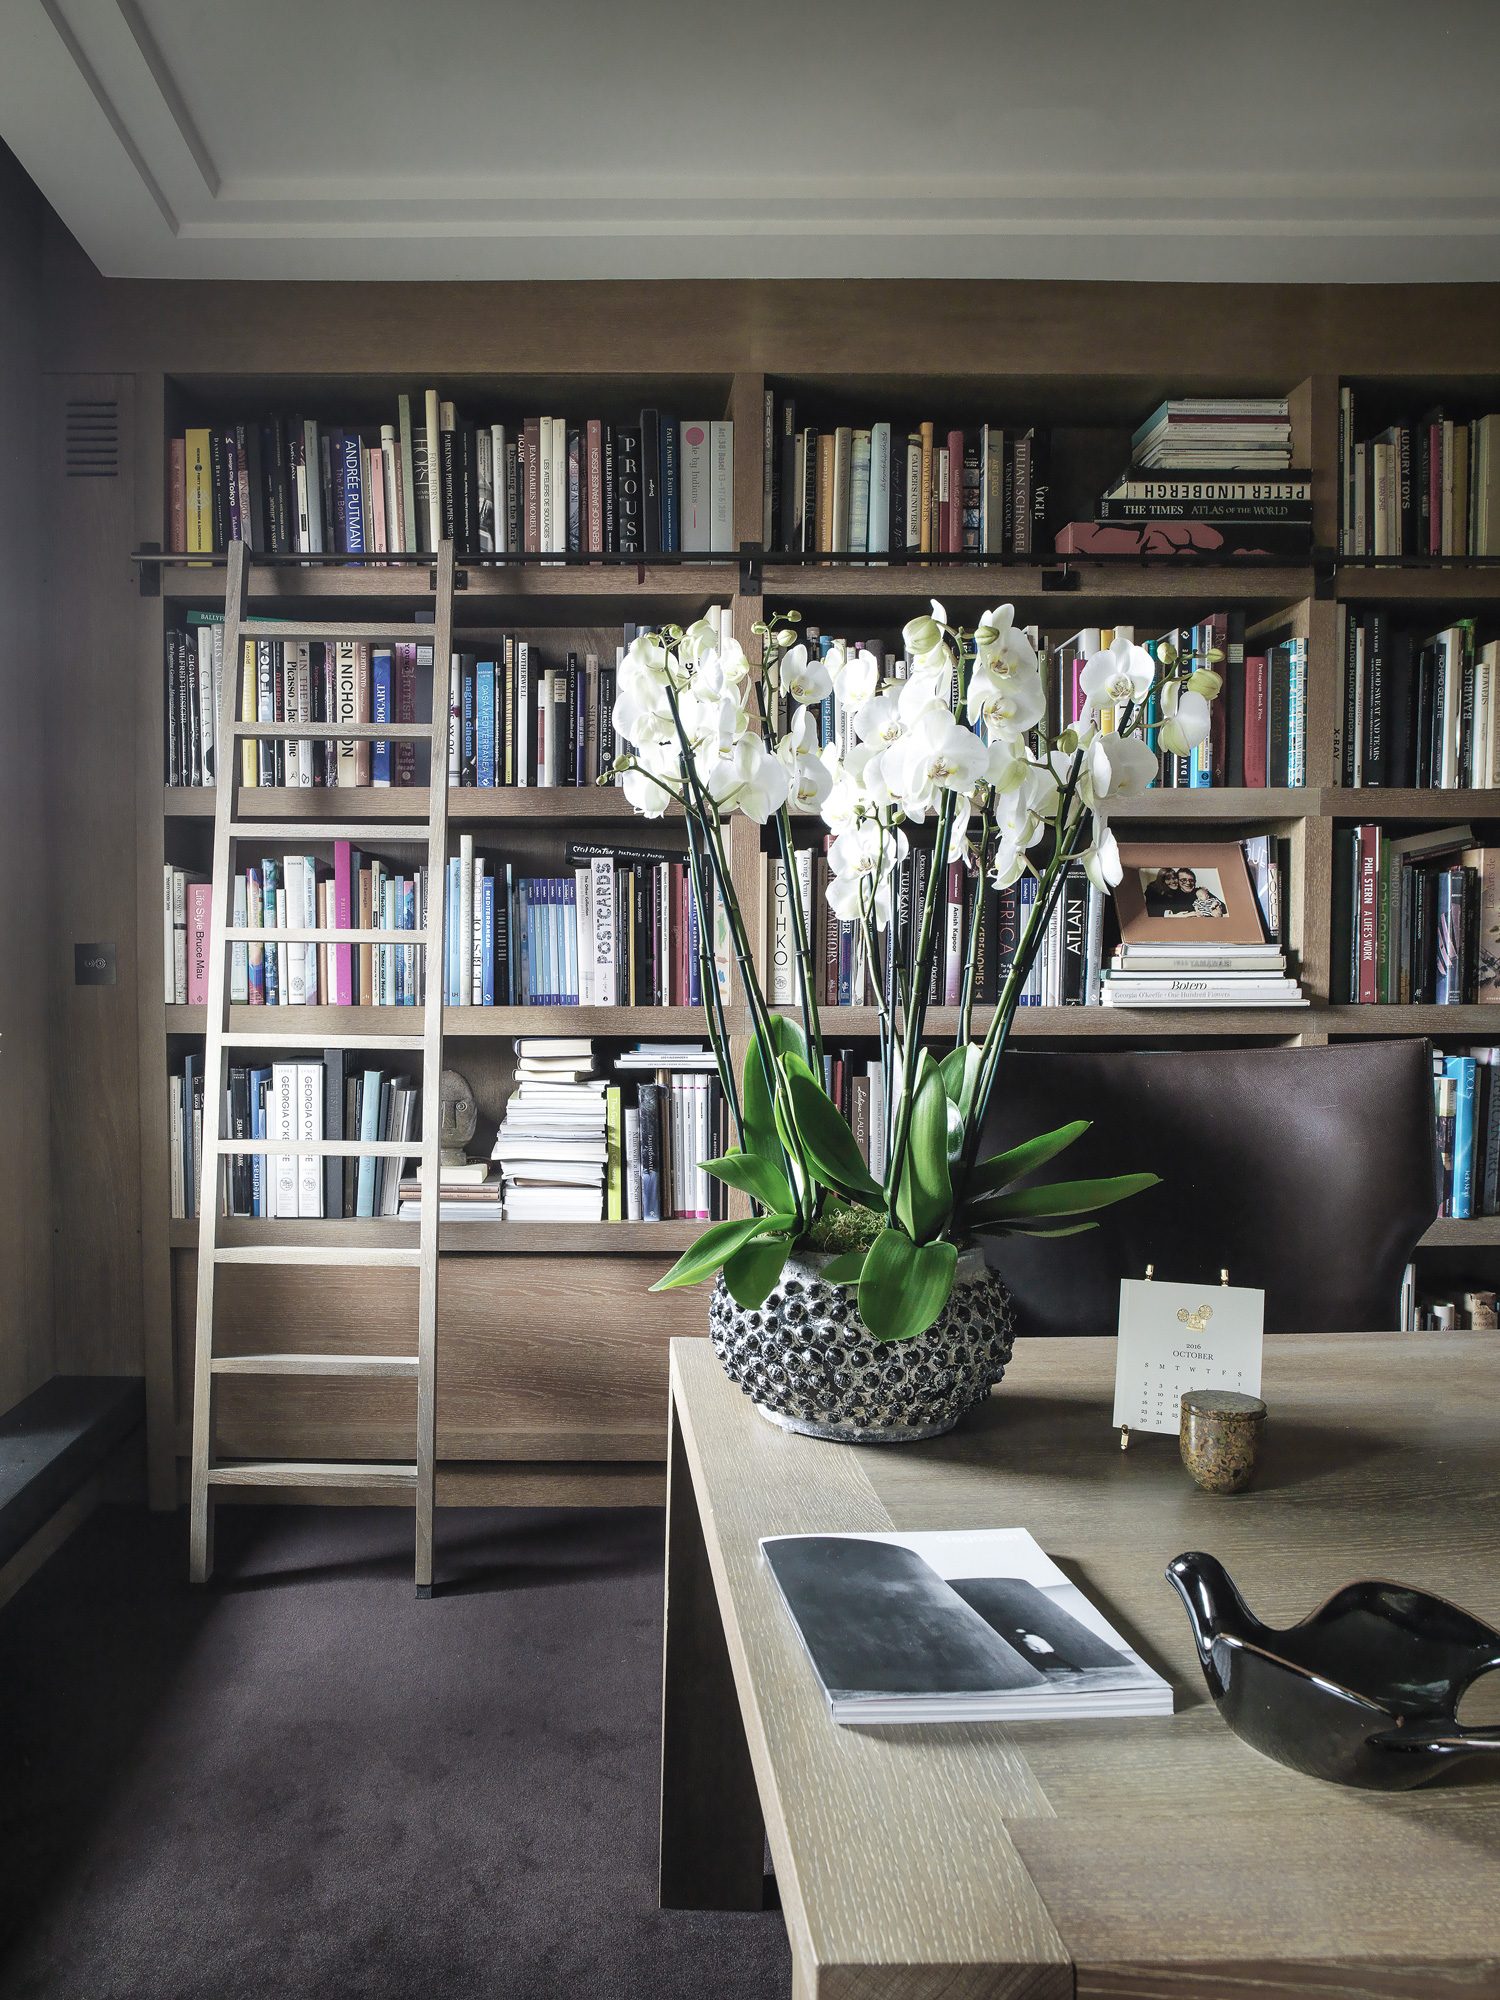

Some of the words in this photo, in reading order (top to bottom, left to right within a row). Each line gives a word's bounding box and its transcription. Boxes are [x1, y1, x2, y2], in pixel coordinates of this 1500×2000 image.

[346, 441, 360, 490] ANDRÉE
[1015, 443, 1026, 485] JULIAN
[1401, 429, 1411, 475] LUXURY
[508, 450, 518, 489] Dressing
[527, 444, 537, 500] JEAN-CHARLES
[910, 453, 919, 494] CALDER'S
[228, 481, 236, 507] Tokyo
[509, 493, 517, 502] in
[624, 437, 638, 552] PROUST
[1034, 485, 1049, 520] VOGUE
[1144, 485, 1246, 498] LINDBERGH
[1251, 485, 1305, 499] PETER
[1402, 479, 1411, 509] TOYS
[337, 501, 345, 521] Book
[347, 494, 362, 548] PUTMAN
[529, 502, 537, 537] MOREUX
[910, 495, 918, 535] UNIVERSE
[1014, 489, 1026, 553] SCHNABEL
[1123, 505, 1147, 515] THE
[1149, 505, 1184, 515] TIMES
[1191, 506, 1224, 515] ATLAS
[1251, 506, 1289, 516] WORLD
[509, 522, 518, 545] Dark
[1349, 616, 1357, 668] SOUTHEAST
[177, 645, 186, 683] WILFRED
[187, 654, 195, 689] CIGARS
[286, 661, 298, 698] Picasso
[299, 659, 308, 671] IN
[519, 648, 527, 699] MOTHERWELL
[1256, 663, 1264, 692] Pentagram
[1374, 657, 1383, 686] BLOOD
[1436, 654, 1445, 686] RICHARD
[299, 678, 308, 700] THE
[463, 677, 474, 720] magnum
[481, 684, 490, 707] CASA
[1348, 669, 1356, 700] SOUTH
[1463, 668, 1474, 719] BAMBUS
[1481, 666, 1490, 705] FLOWERS
[201, 670, 211, 738] CALLAS
[299, 707, 308, 723] PIN
[376, 684, 386, 723] BOGART
[1374, 687, 1382, 715] SWEAT
[1436, 687, 1444, 719] GILLETTE
[465, 721, 474, 757] cinema
[586, 704, 597, 743] SHAKER
[481, 708, 490, 773] MEDITERRANEA
[1333, 728, 1341, 760] X-RAY
[1372, 734, 1381, 761] TEARS
[801, 856, 810, 878] Irving
[1363, 856, 1374, 877] PHIL
[1391, 855, 1401, 908] MONDINO
[1485, 872, 1496, 891] Arts
[195, 889, 205, 906] Life
[802, 879, 810, 897] Penn
[900, 870, 910, 926] TURKANA
[1363, 878, 1374, 904] STERN
[1485, 894, 1495, 909] Les
[193, 907, 205, 930] Style
[595, 863, 613, 965] POSTCARDS
[773, 866, 788, 966] ROTHKO
[999, 888, 1015, 956] AFRICA
[1066, 899, 1083, 955] ATLAN
[1363, 917, 1373, 938] LIFE'S
[195, 931, 205, 958] Bruce
[826, 907, 838, 965] WARRIORS
[951, 928, 959, 952] Kapoor
[1362, 939, 1373, 961] WORK
[196, 959, 205, 980] Mau
[1171, 980, 1208, 991] Botero
[1114, 991, 1138, 999] Georgia
[280, 1075, 290, 1118] GEORGIA
[304, 1075, 313, 1118] GEORGIA
[1465, 1064, 1475, 1098] POOLS
[280, 1120, 290, 1163] O'KEFE
[304, 1120, 313, 1163] O'KEFE
[632, 1131, 640, 1148] Man
[632, 1149, 640, 1163] with
[1486, 1144, 1498, 1178] ARK
[252, 1164, 260, 1200] Médinas
[632, 1170, 640, 1185] Blue
[632, 1186, 641, 1203] Scarf
[1172, 1350, 1214, 1361] OCTOBER
